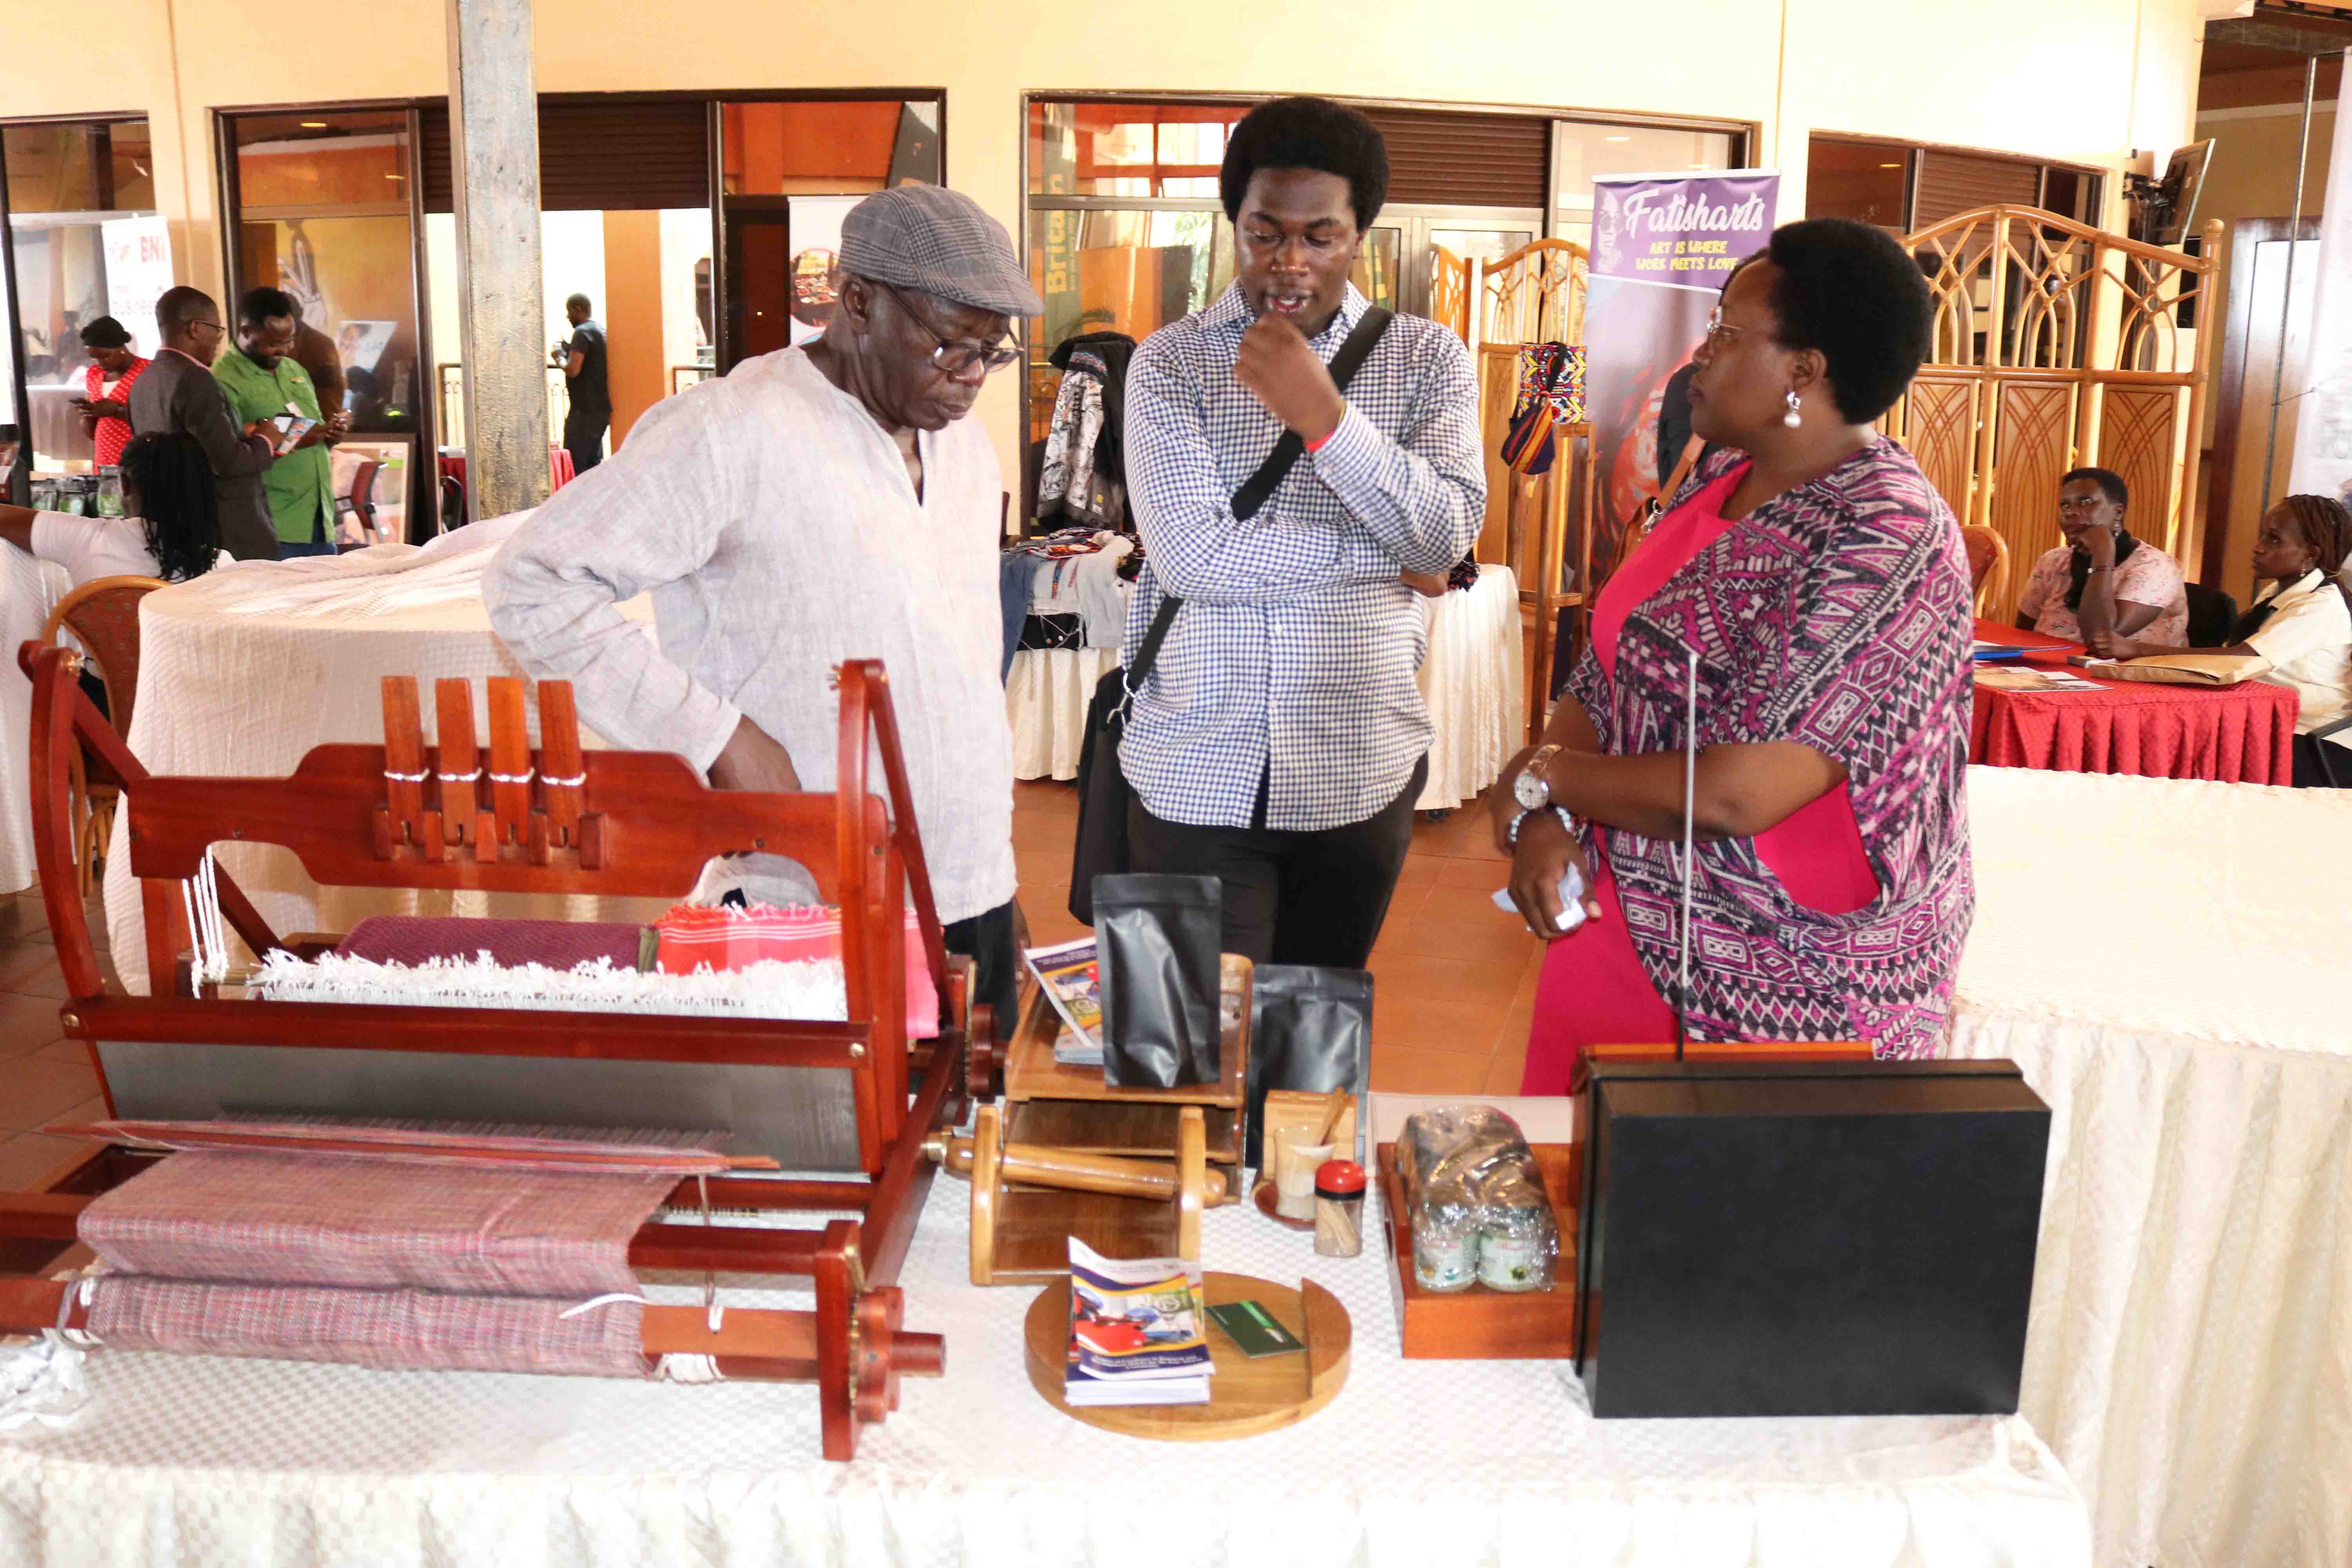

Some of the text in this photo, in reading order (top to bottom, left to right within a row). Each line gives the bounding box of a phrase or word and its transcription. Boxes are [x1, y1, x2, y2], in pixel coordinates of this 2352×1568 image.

[1624, 188, 1765, 238] Fatisharts
[1650, 240, 1728, 254] ART IS WHERE
[1636, 257, 1666, 270] WORK
[1669, 257, 1705, 270] MEETS
